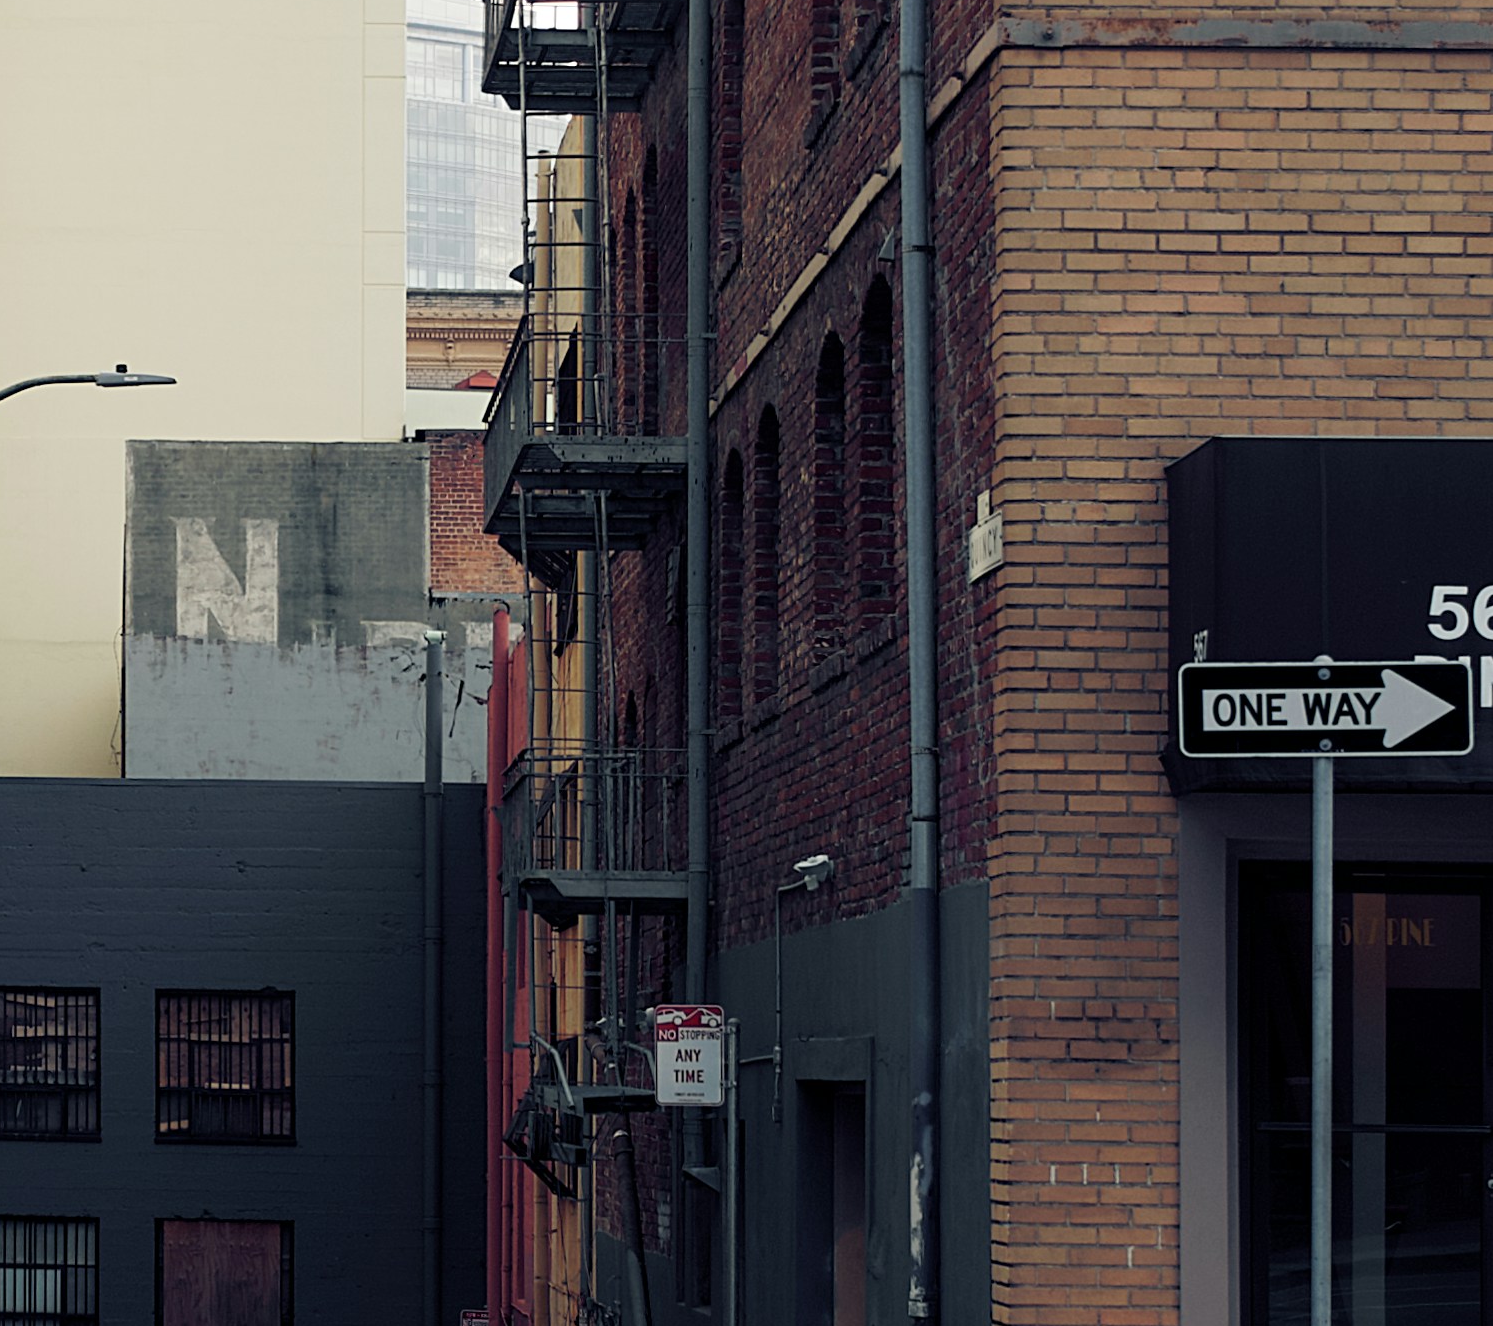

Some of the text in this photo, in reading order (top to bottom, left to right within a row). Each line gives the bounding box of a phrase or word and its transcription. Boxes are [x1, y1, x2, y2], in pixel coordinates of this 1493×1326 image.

[1214, 692, 1381, 727] ONE WAY
[1386, 917, 1436, 947] PINE
[658, 1029, 721, 1041] NO STOPPING
[676, 1049, 701, 1062] ANY
[674, 1069, 705, 1083] TIME
